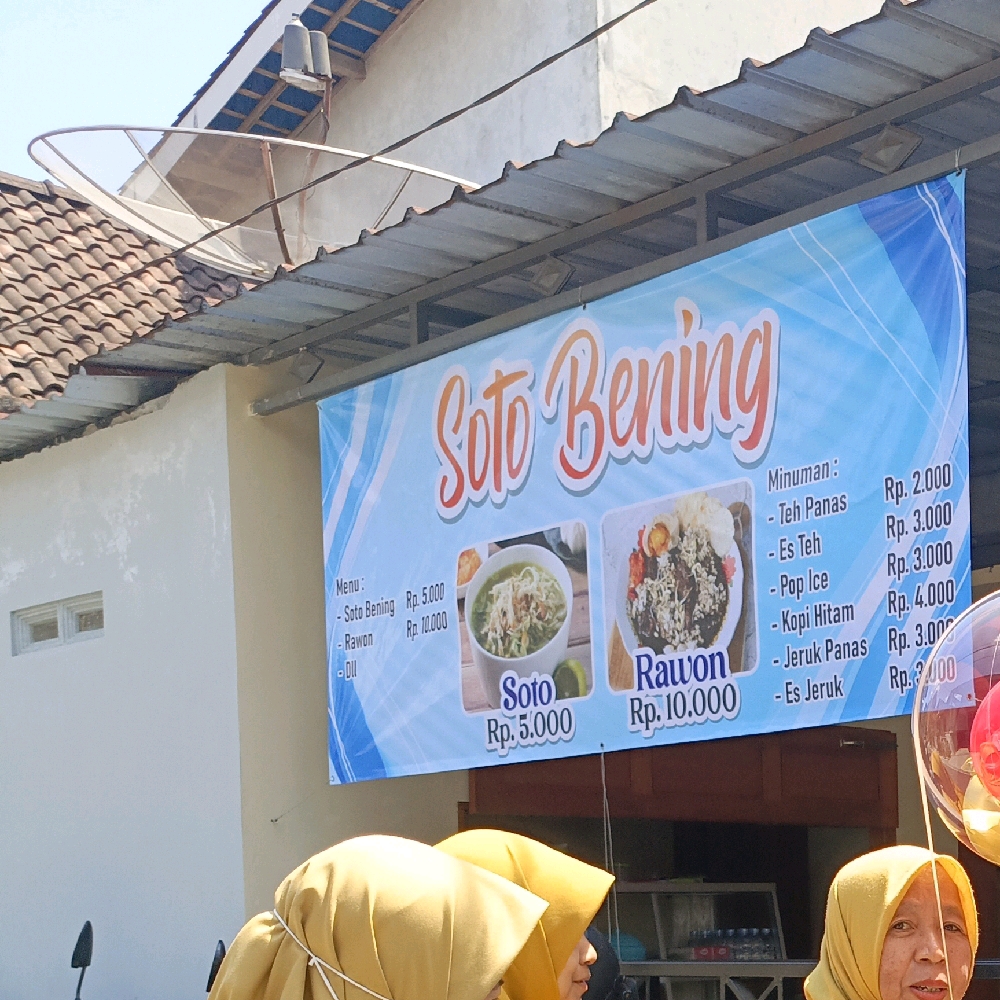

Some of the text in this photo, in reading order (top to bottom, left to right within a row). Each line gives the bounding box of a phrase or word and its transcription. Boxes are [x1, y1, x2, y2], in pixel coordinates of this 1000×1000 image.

[437, 309, 772, 509] Soto Bening
[768, 461, 830, 492] Minuman
[884, 463, 951, 505] Rp. 2.000
[779, 500, 801, 525] Teh
[805, 494, 848, 520] Panas
[886, 502, 952, 543] Rp. 3.000
[780, 539, 794, 561] Es
[798, 532, 822, 557] Teh
[887, 541, 953, 580] Rp. 3.000
[336, 578, 360, 597] Menu
[406, 582, 445, 612] Rp. 5.000
[780, 574, 804, 600] Pop
[808, 569, 829, 592] Ice
[888, 579, 954, 618] Rp. 4.000
[344, 604, 363, 623] Soto
[365, 596, 395, 618] Bening
[782, 606, 811, 635] Kopi
[814, 603, 855, 627] Hitam
[406, 611, 448, 641] Rp. 10.000
[345, 633, 374, 651] Rawon
[784, 641, 822, 669] Jeruk
[825, 638, 868, 662] Panas
[888, 628, 911, 656] Rp.
[635, 650, 727, 691] Rawon
[889, 665, 912, 694] Rp.
[502, 675, 552, 711] Soto
[785, 682, 804, 705] Es
[805, 675, 844, 702] Jeruk
[629, 683, 738, 730] Rp. 10.000
[486, 707, 573, 750] Rp. 5.000
